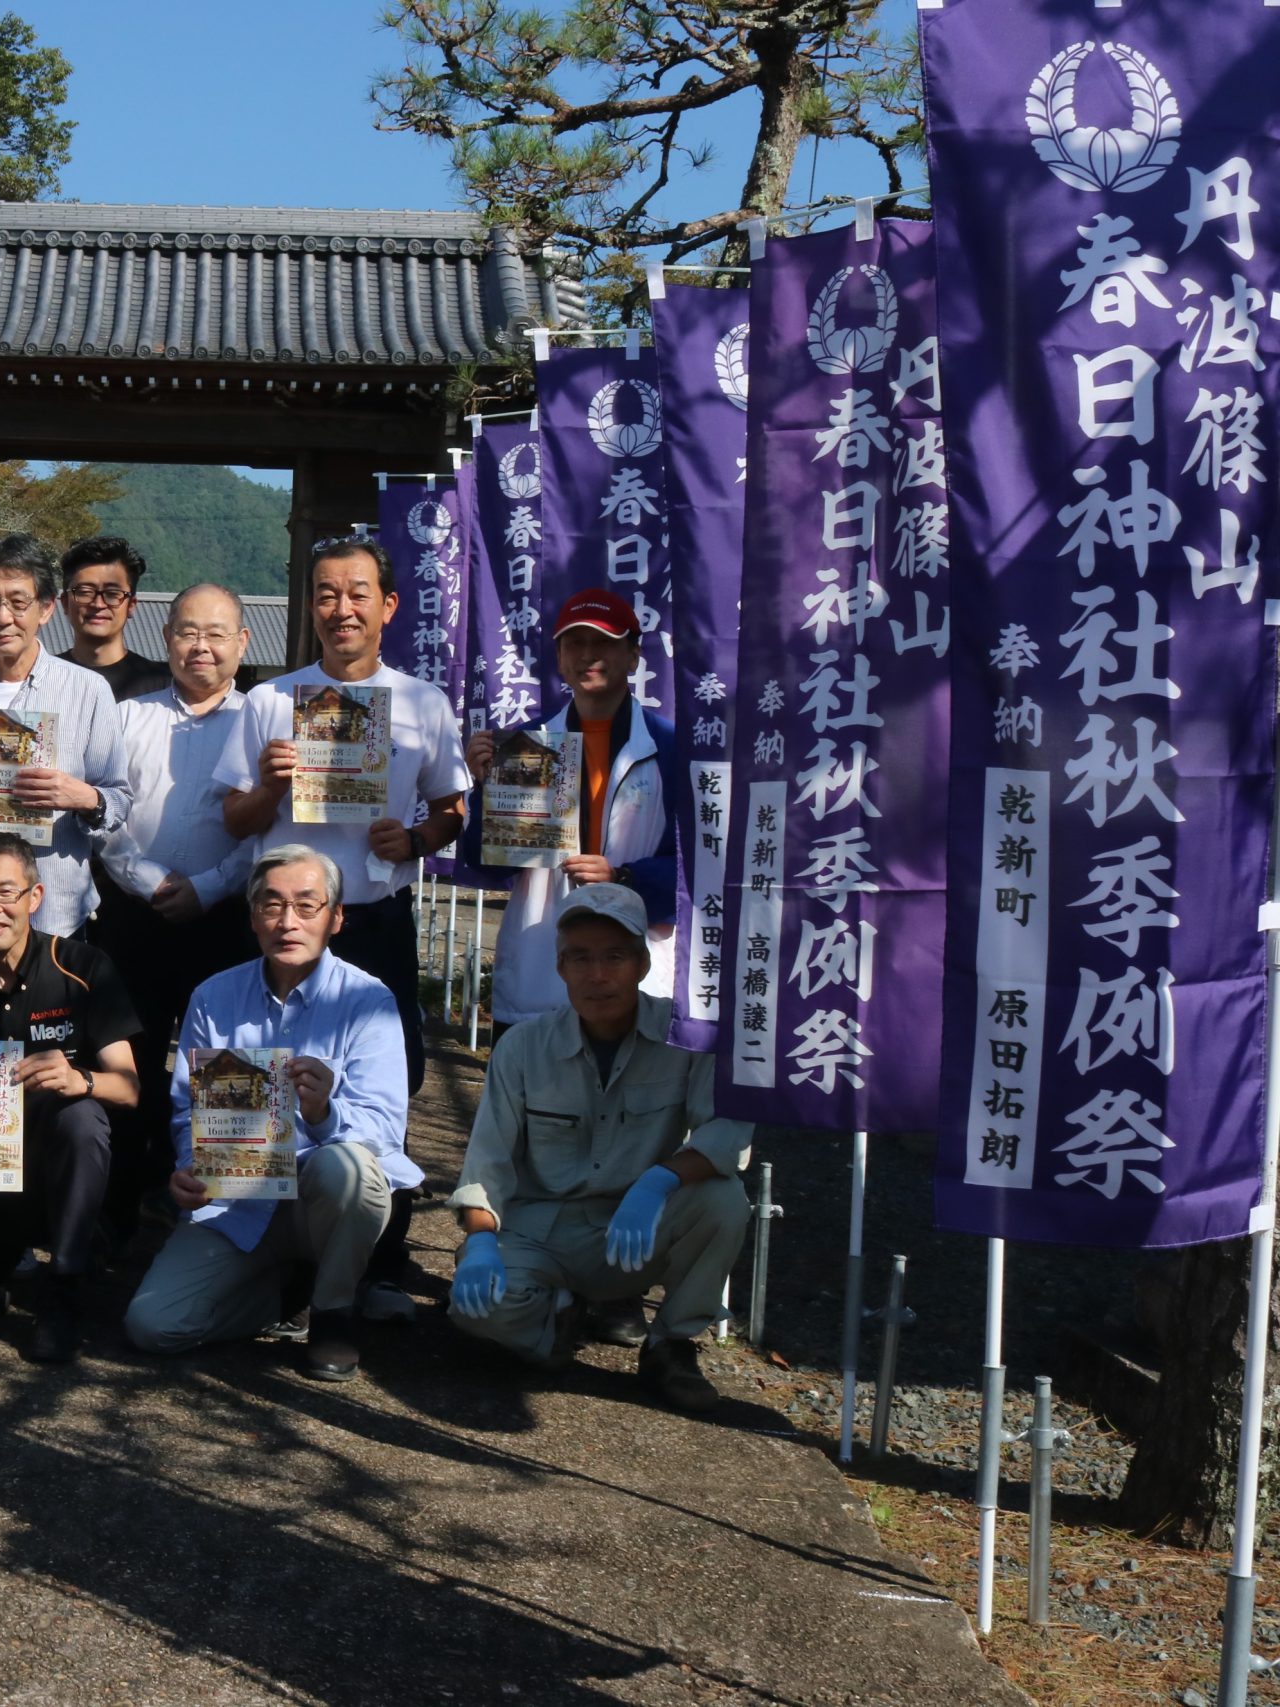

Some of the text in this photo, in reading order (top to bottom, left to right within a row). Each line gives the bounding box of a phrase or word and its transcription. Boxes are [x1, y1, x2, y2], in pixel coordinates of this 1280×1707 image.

[1173, 156, 1266, 604] 丹波篠山
[888, 334, 950, 659] 丹波篠山
[412, 550, 449, 688] 春日神社
[488, 505, 543, 730] 春日神社秋
[988, 622, 1043, 749] 奉納
[1054, 213, 1186, 1200] 春日神社秋季例祭
[693, 672, 727, 748] 奉納
[753, 679, 786, 766] 奉納
[785, 388, 894, 1095] 春日神社秋季例祭
[695, 770, 724, 1009] 乾新町 谷田幸子
[751, 804, 778, 901] 乾新町
[30, 1020, 74, 1042] Magic
[31, 1008, 72, 1021] AsahiKA
[979, 783, 1038, 1171] 乾新町 原田拓朗
